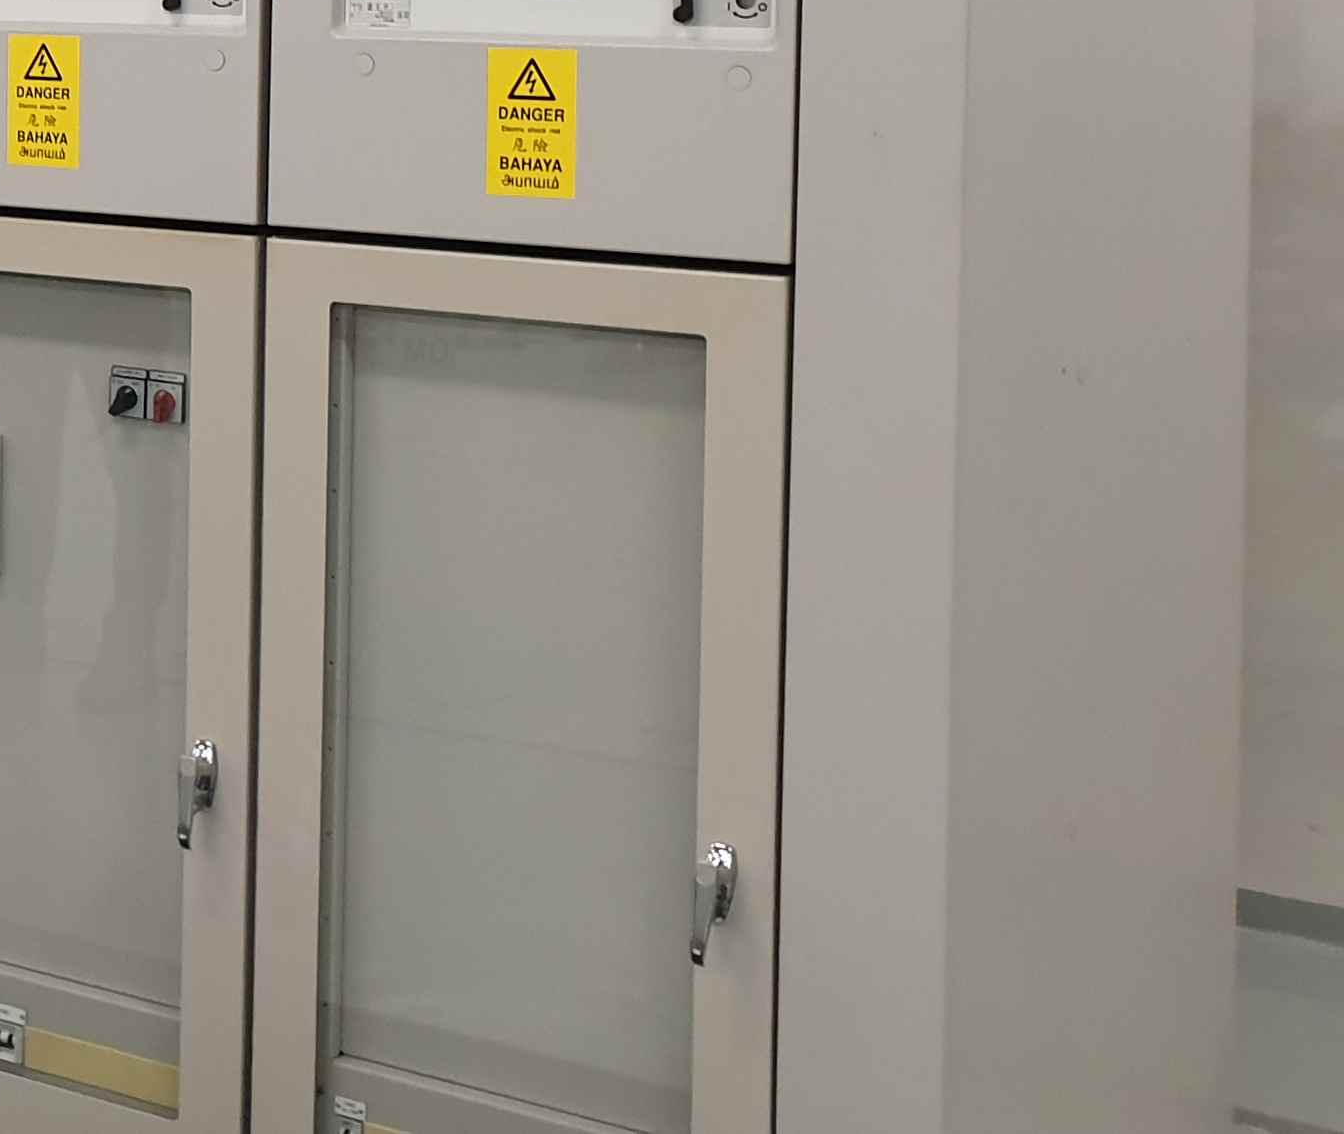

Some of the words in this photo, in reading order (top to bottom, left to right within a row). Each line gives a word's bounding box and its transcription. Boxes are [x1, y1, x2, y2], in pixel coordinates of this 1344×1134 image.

[16, 86, 70, 100] DANGER
[498, 106, 565, 123] DANGER
[17, 130, 68, 146] BAHAYA
[499, 156, 563, 173] BAHAYA
